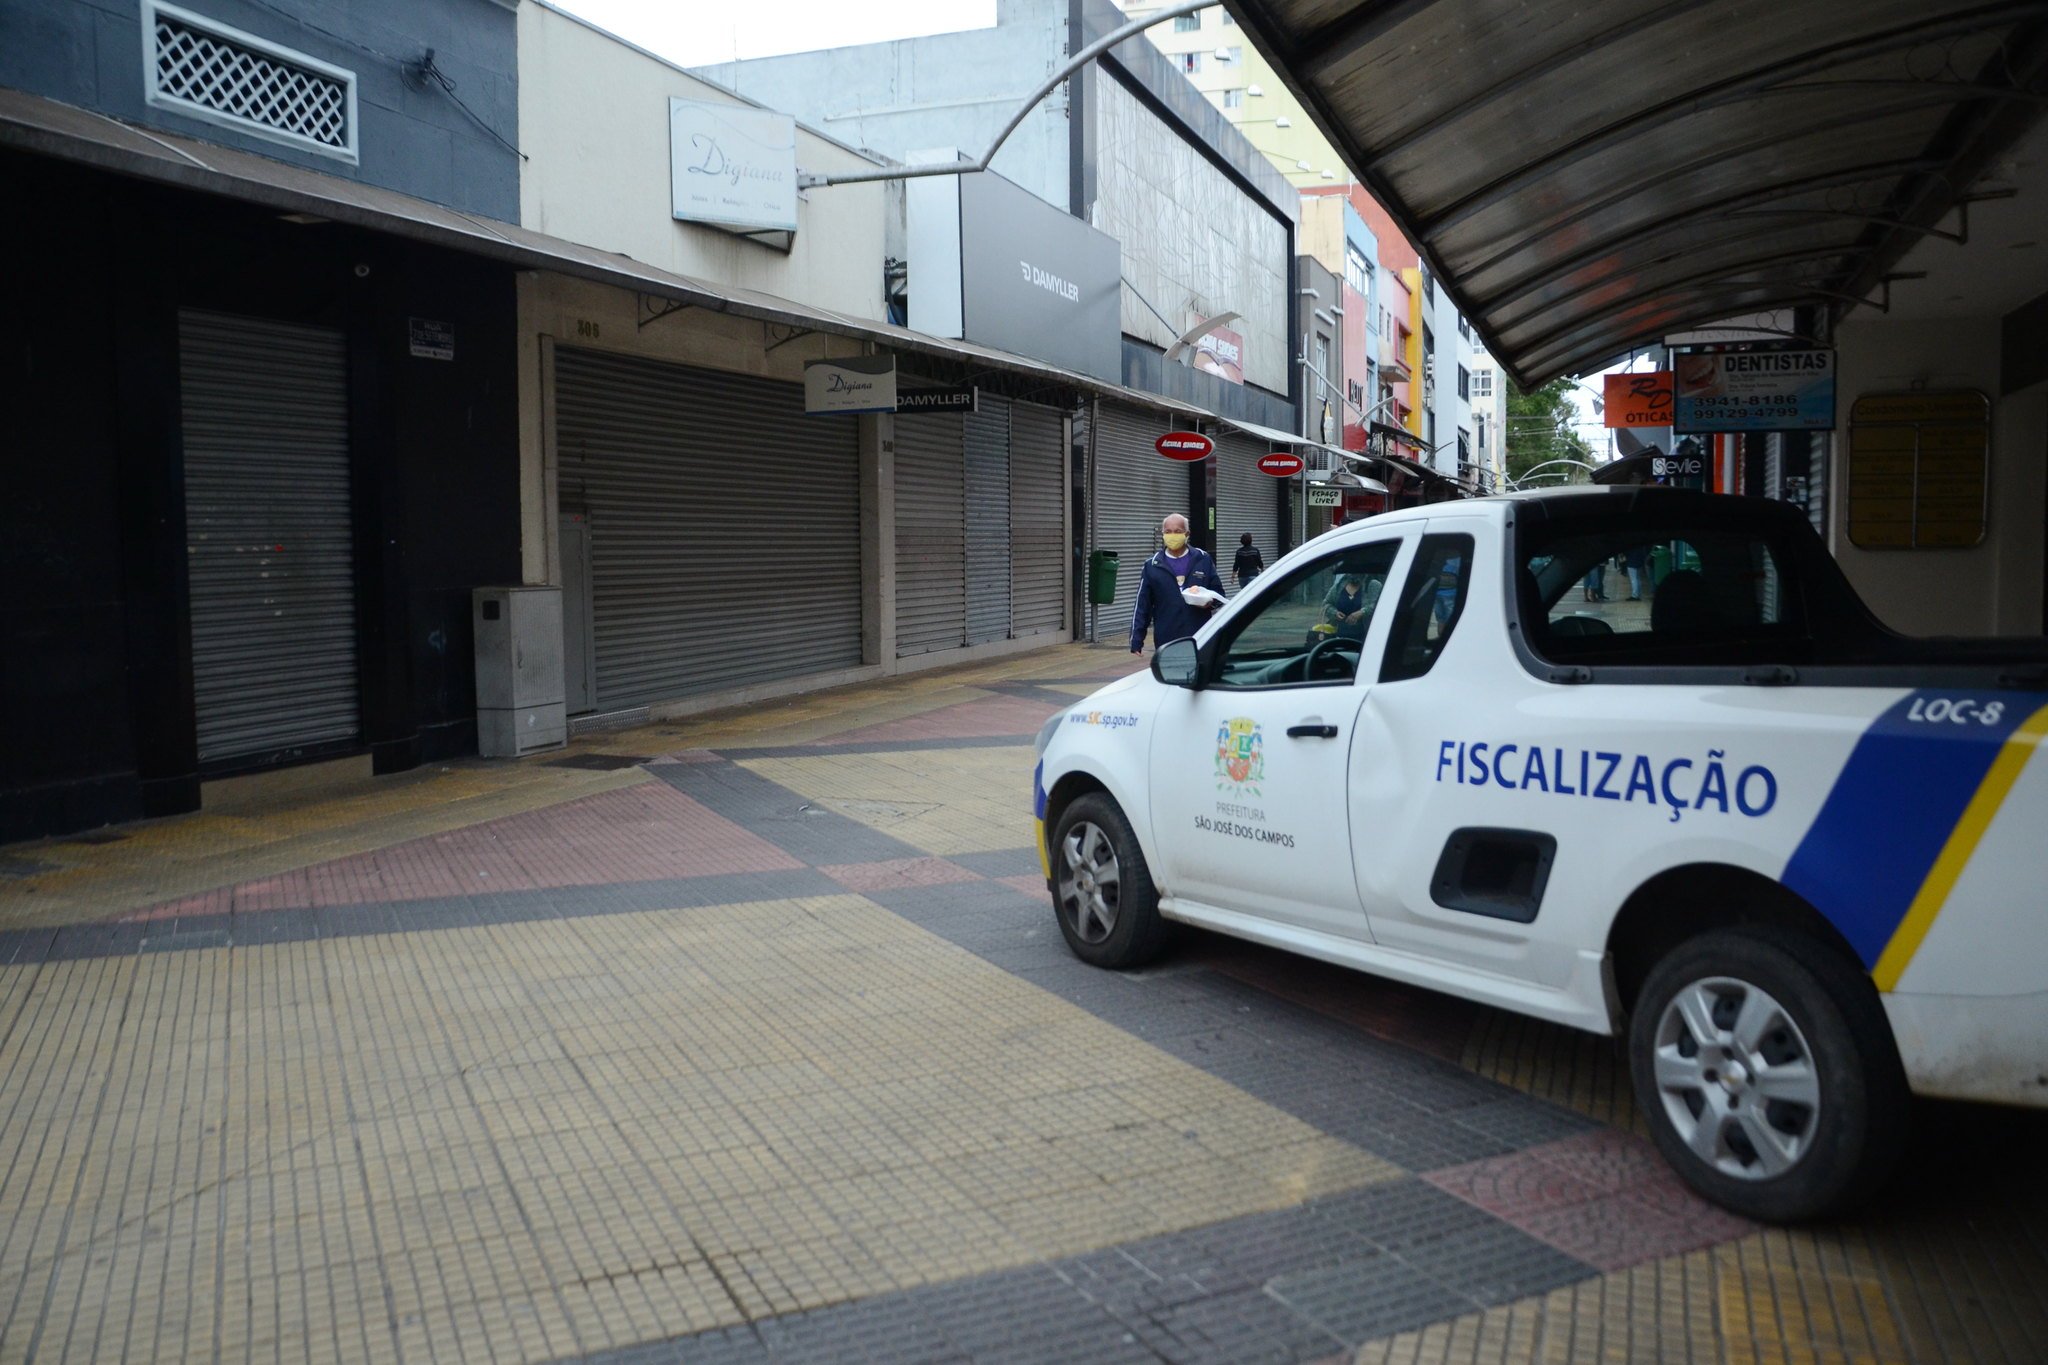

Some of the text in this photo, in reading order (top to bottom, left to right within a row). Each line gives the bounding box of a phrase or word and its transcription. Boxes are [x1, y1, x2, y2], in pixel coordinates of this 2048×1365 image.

[687, 132, 784, 186] Digiana
[1033, 266, 1079, 303] DAMYLLER
[1724, 353, 1827, 373] DENTISTAS
[826, 372, 873, 396] Digiana
[896, 393, 971, 406] DAMYLLER
[1694, 394, 1798, 407] 3941-8186
[1694, 407, 1799, 419] 99129-4799
[1182, 441, 1206, 450] SHOES
[1907, 697, 2006, 726] LOC-8
[1436, 739, 1779, 823] FISCALIZAÇÃO
[1216, 801, 1266, 822] PREFEITURA
[1194, 815, 1296, 848] SÃO JOSÉ DOS CAMPOS
